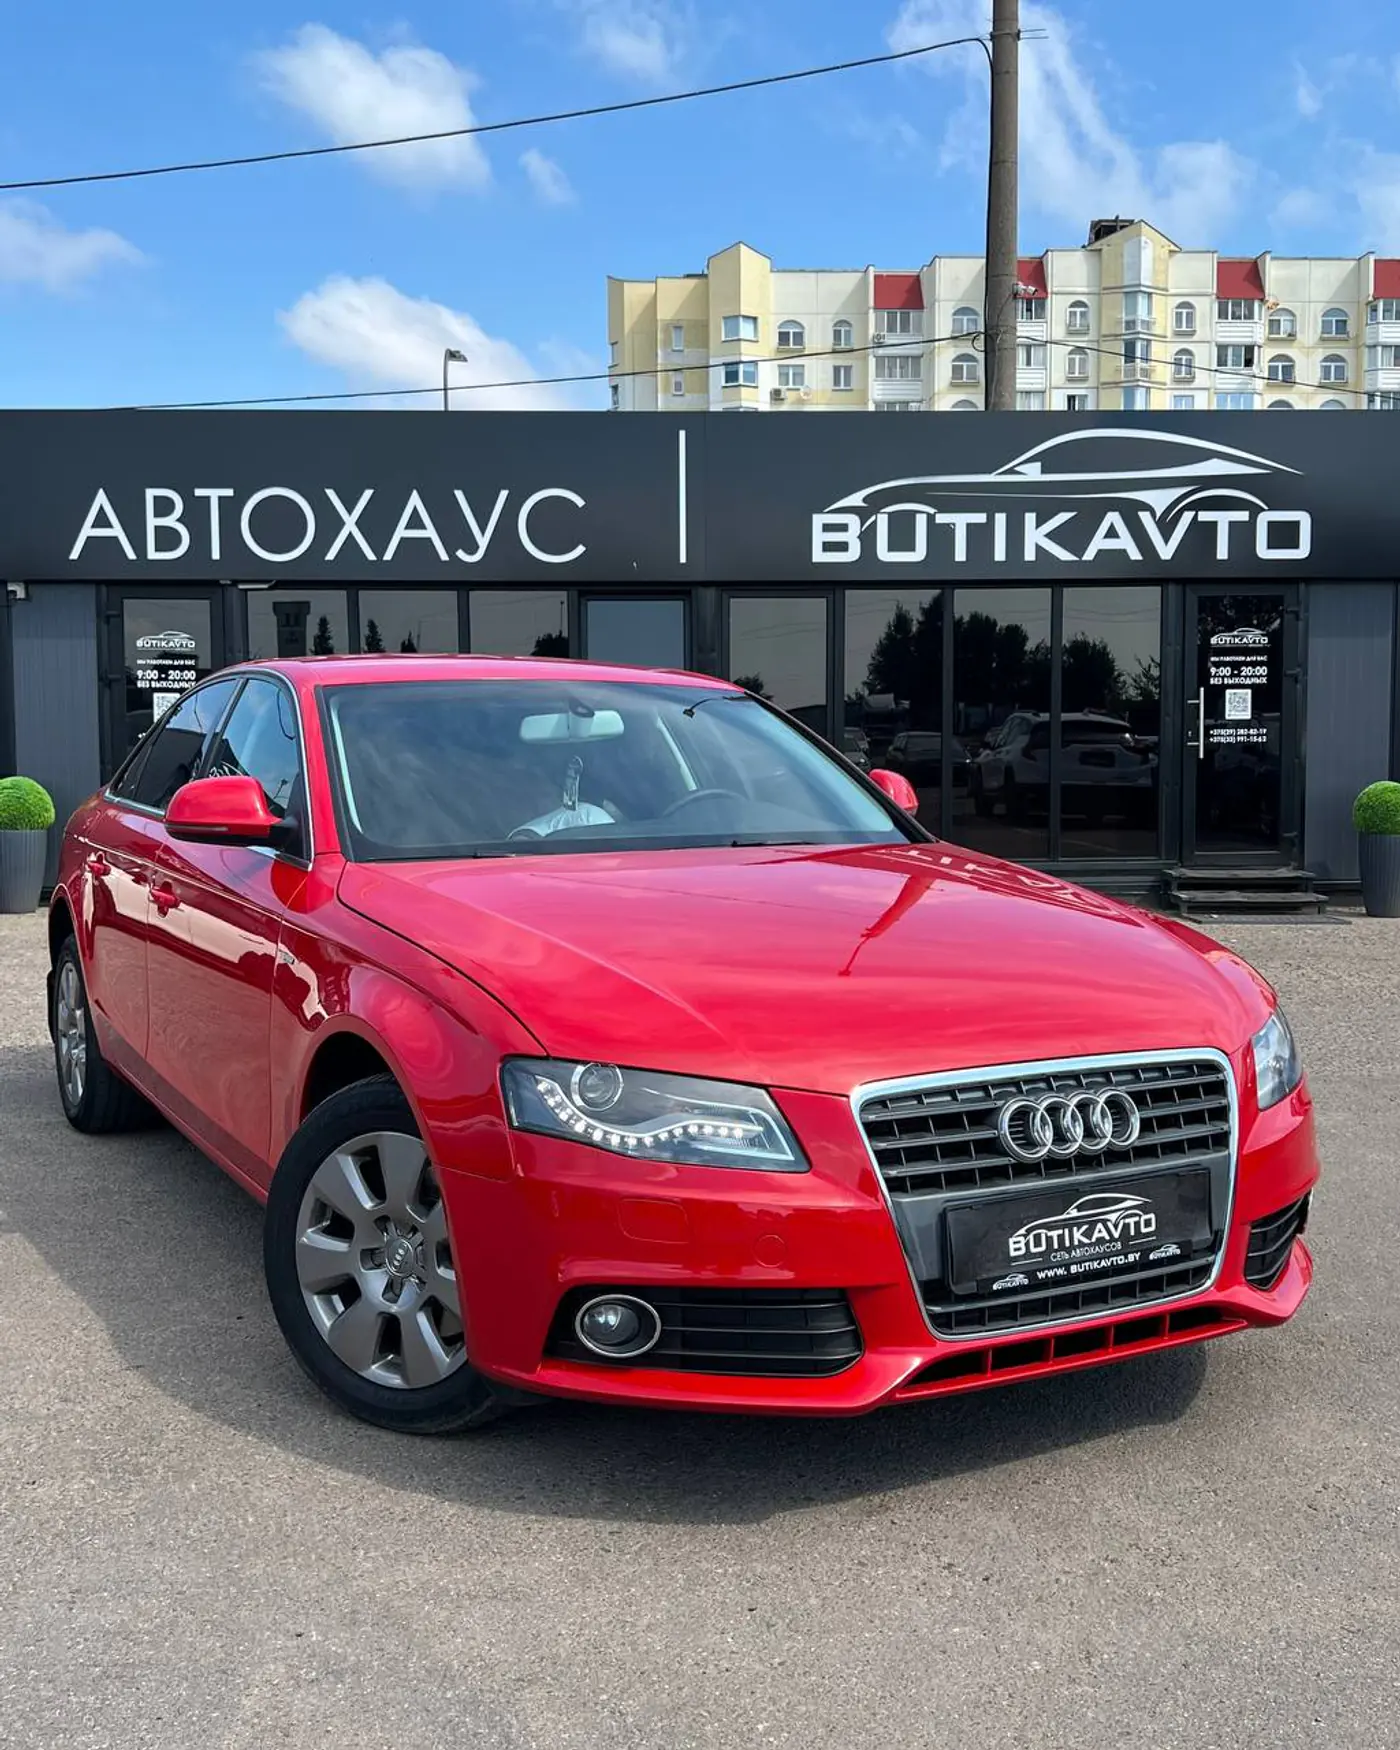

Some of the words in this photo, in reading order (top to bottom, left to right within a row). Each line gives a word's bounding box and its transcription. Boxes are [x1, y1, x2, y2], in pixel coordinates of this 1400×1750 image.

[69, 486, 587, 564] АВТОХАУС
[811, 509, 1311, 563] BUTIKAVTO
[136, 640, 196, 648] BUTIKAVTO
[137, 670, 158, 680] 9:00
[168, 670, 196, 680] 20:00
[1210, 666, 1231, 676] 9:00
[1240, 666, 1268, 676] 20:00
[1008, 1213, 1156, 1257] BUTIKAVTO
[1050, 1249, 1069, 1262] СЕТЬ
[1070, 1241, 1122, 1259] АВТОХАУСОВ
[1036, 1267, 1068, 1280] WWW.
[1070, 1251, 1142, 1275] BUTIKAVTO.BY
